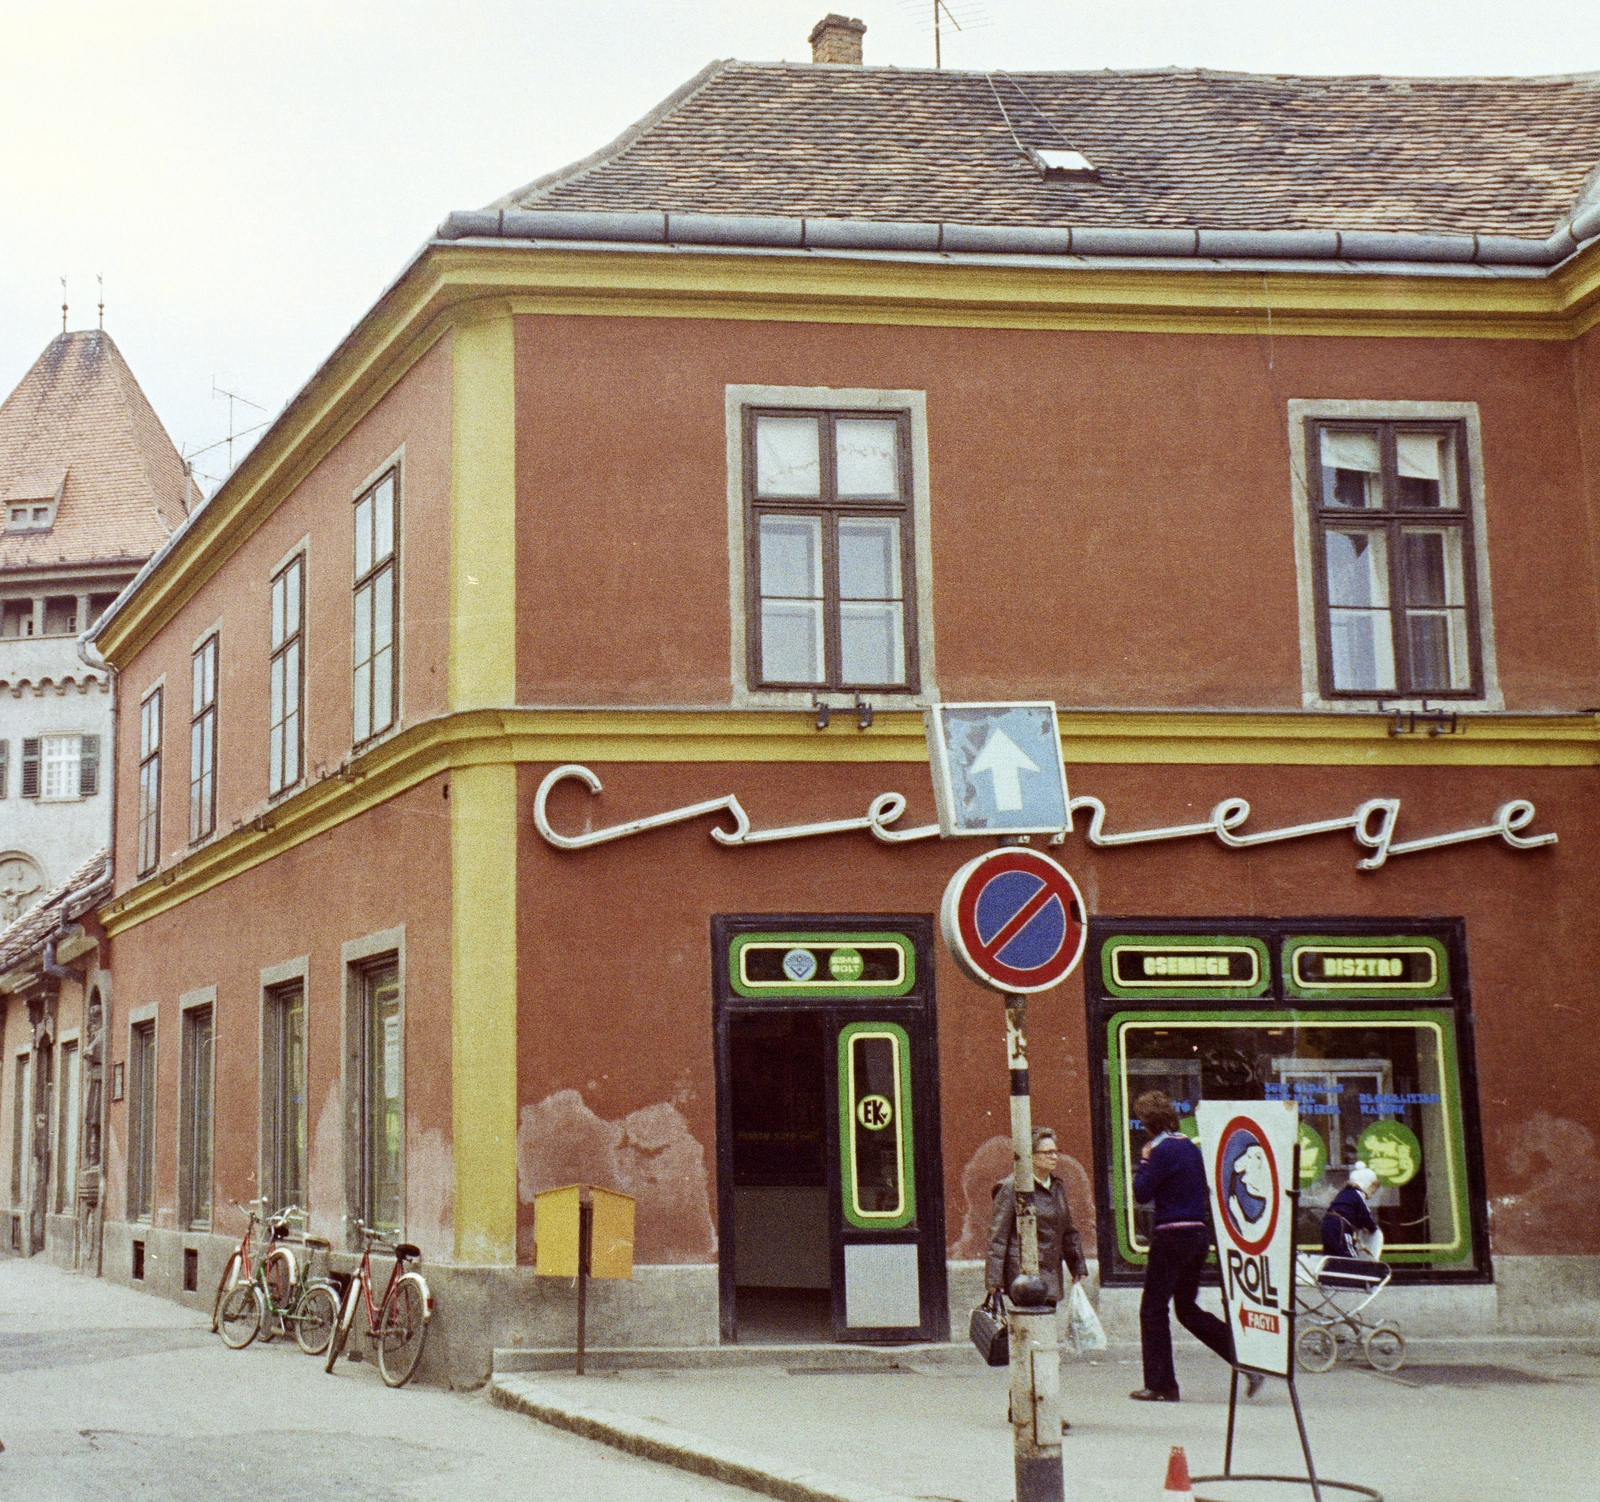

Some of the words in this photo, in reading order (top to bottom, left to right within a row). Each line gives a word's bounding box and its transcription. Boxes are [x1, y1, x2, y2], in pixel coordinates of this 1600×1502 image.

[1143, 956, 1230, 976] CSEMEGE
[1227, 1248, 1279, 1308] ROLL
[1247, 1311, 1275, 1331] FAGYI
